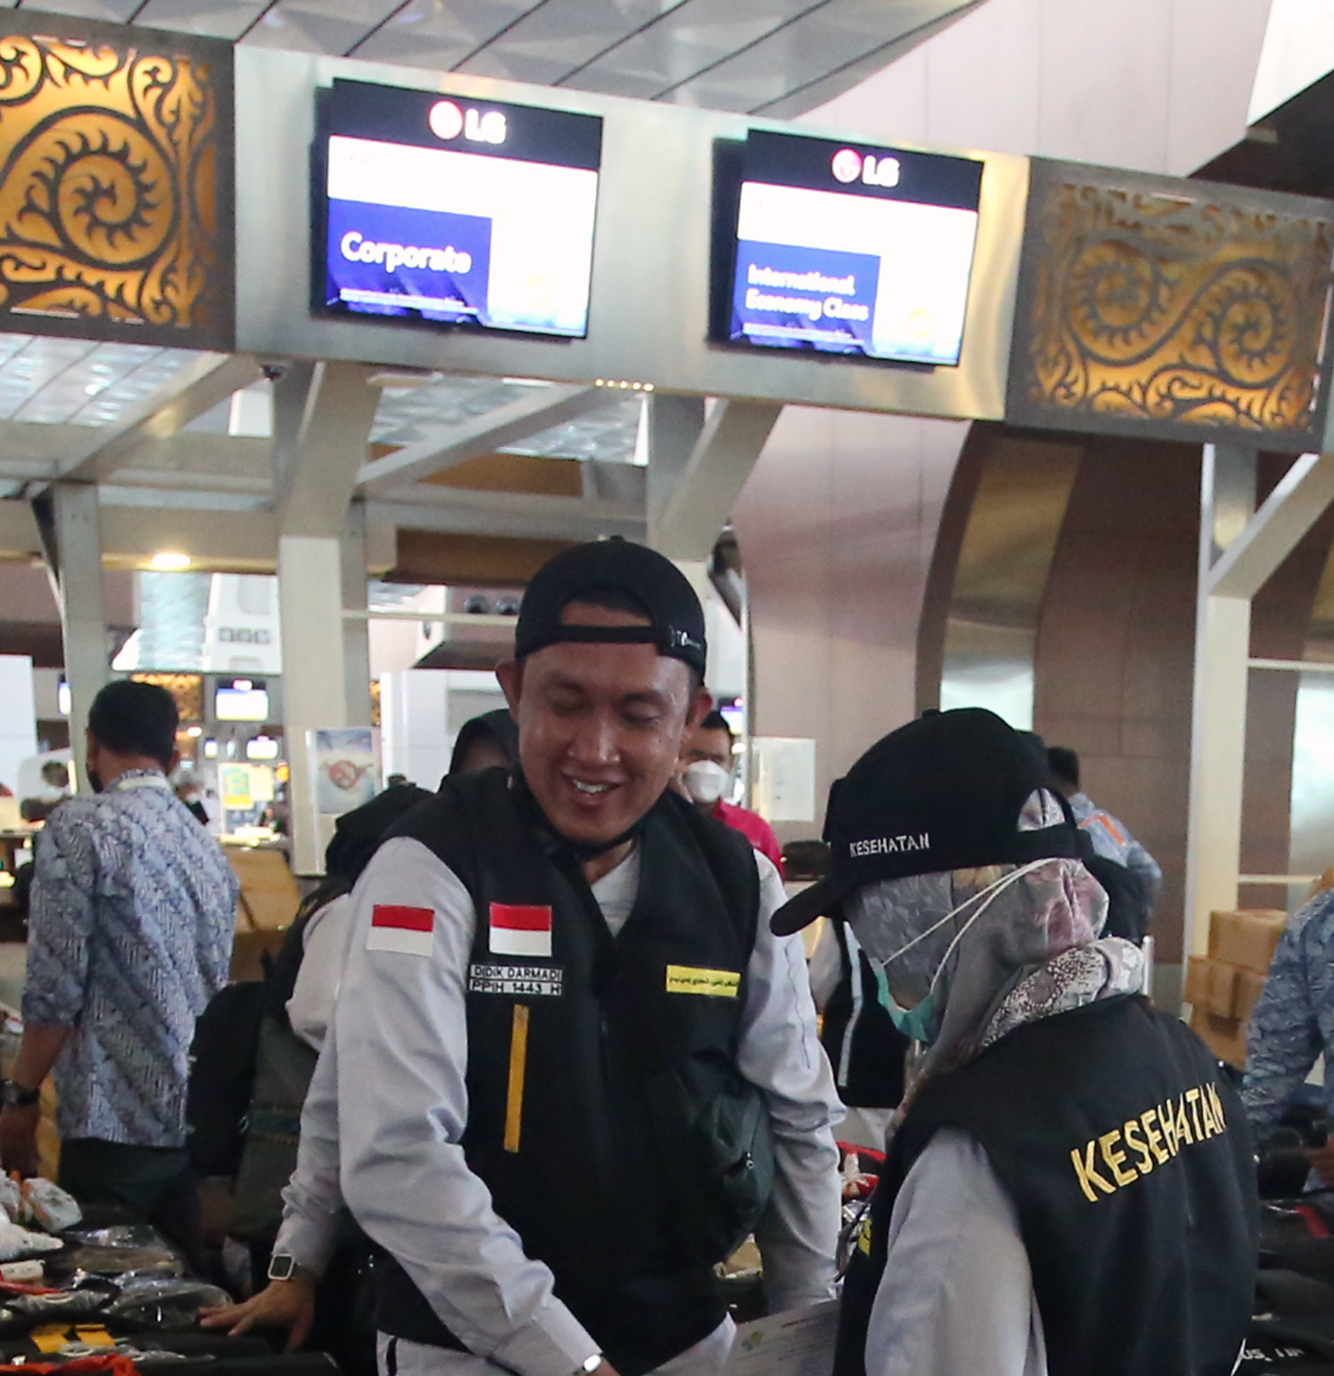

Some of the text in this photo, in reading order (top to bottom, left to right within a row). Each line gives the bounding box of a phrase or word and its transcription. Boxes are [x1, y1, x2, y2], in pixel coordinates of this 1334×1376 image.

[465, 108, 507, 144] LG
[862, 155, 901, 187] LG
[340, 231, 473, 273] Corporate
[849, 832, 930, 858] KESEHATAN
[472, 980, 504, 993] PPIH
[550, 984, 560, 994] H
[1070, 1081, 1227, 1203] KESEHATAN
